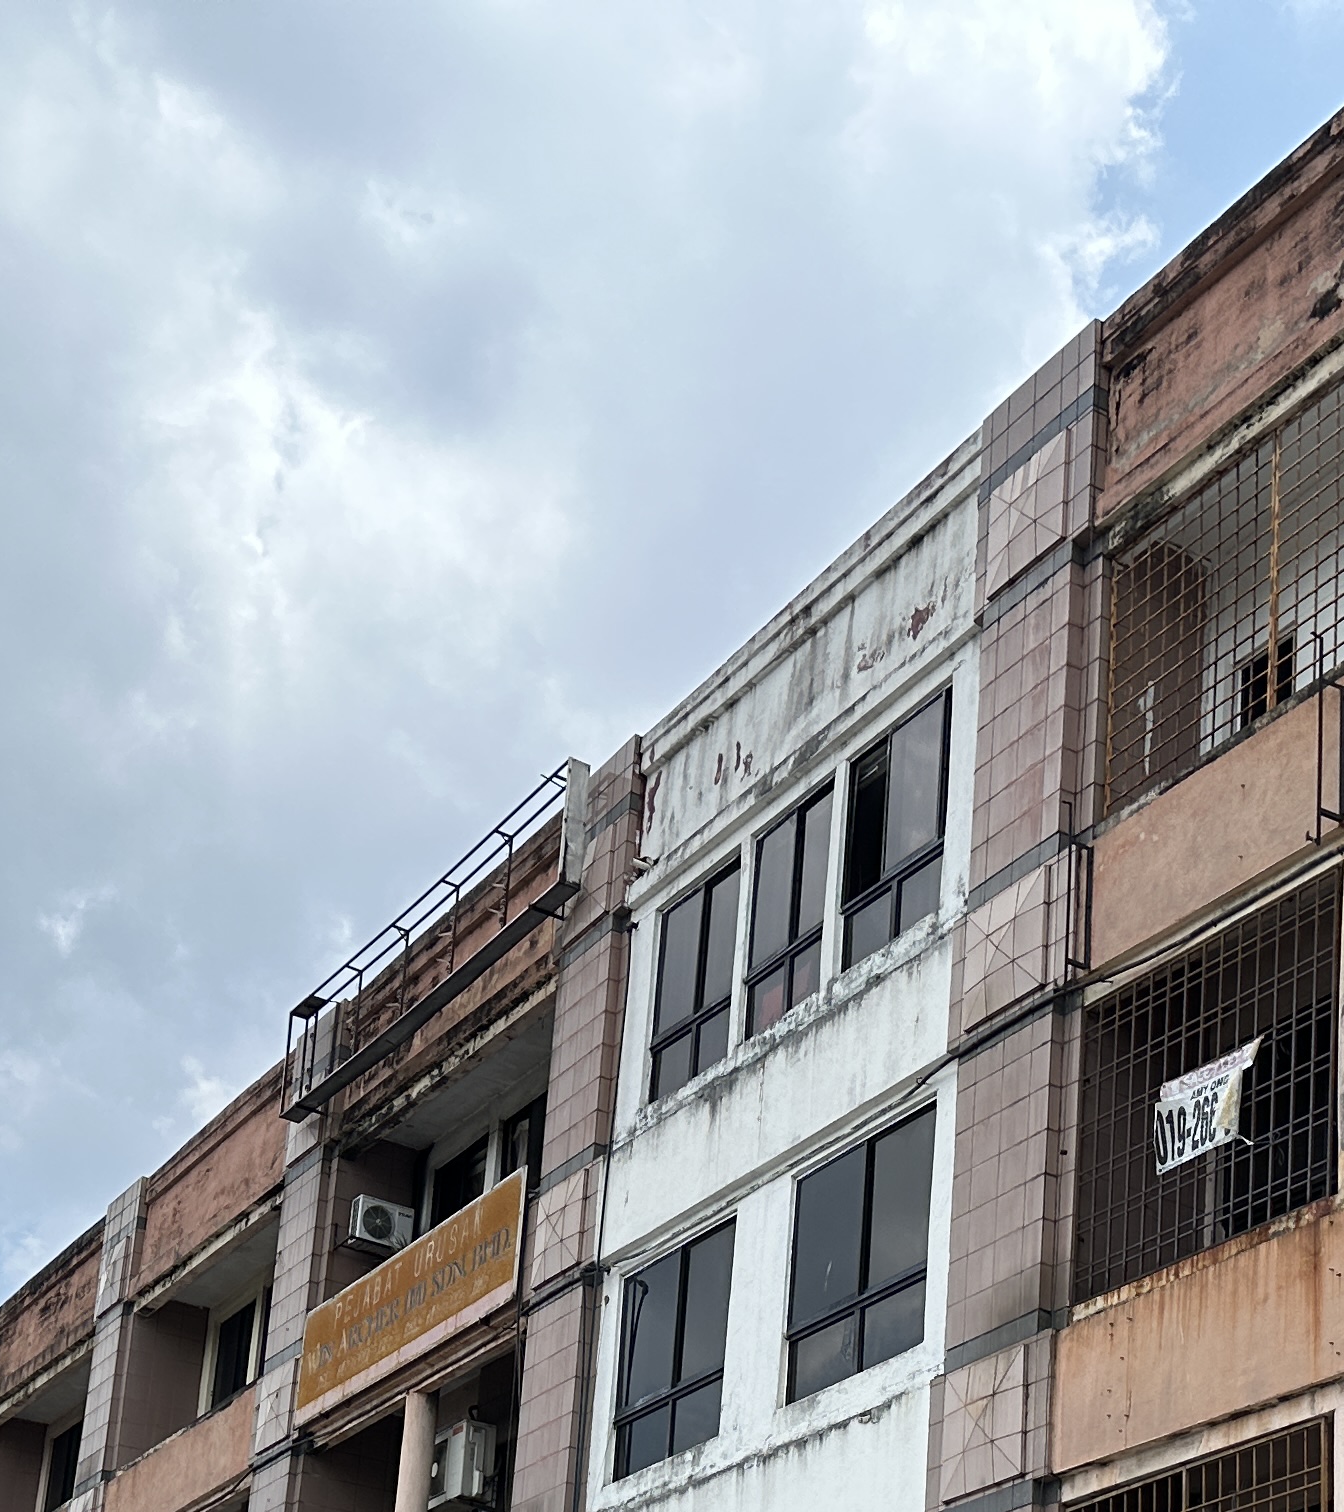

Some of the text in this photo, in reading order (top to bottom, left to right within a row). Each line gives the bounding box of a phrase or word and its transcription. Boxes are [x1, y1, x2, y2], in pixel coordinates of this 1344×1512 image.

[1190, 1074, 1230, 1100] AMY ONG
[334, 1206, 484, 1329] PEJABAT URUSAN
